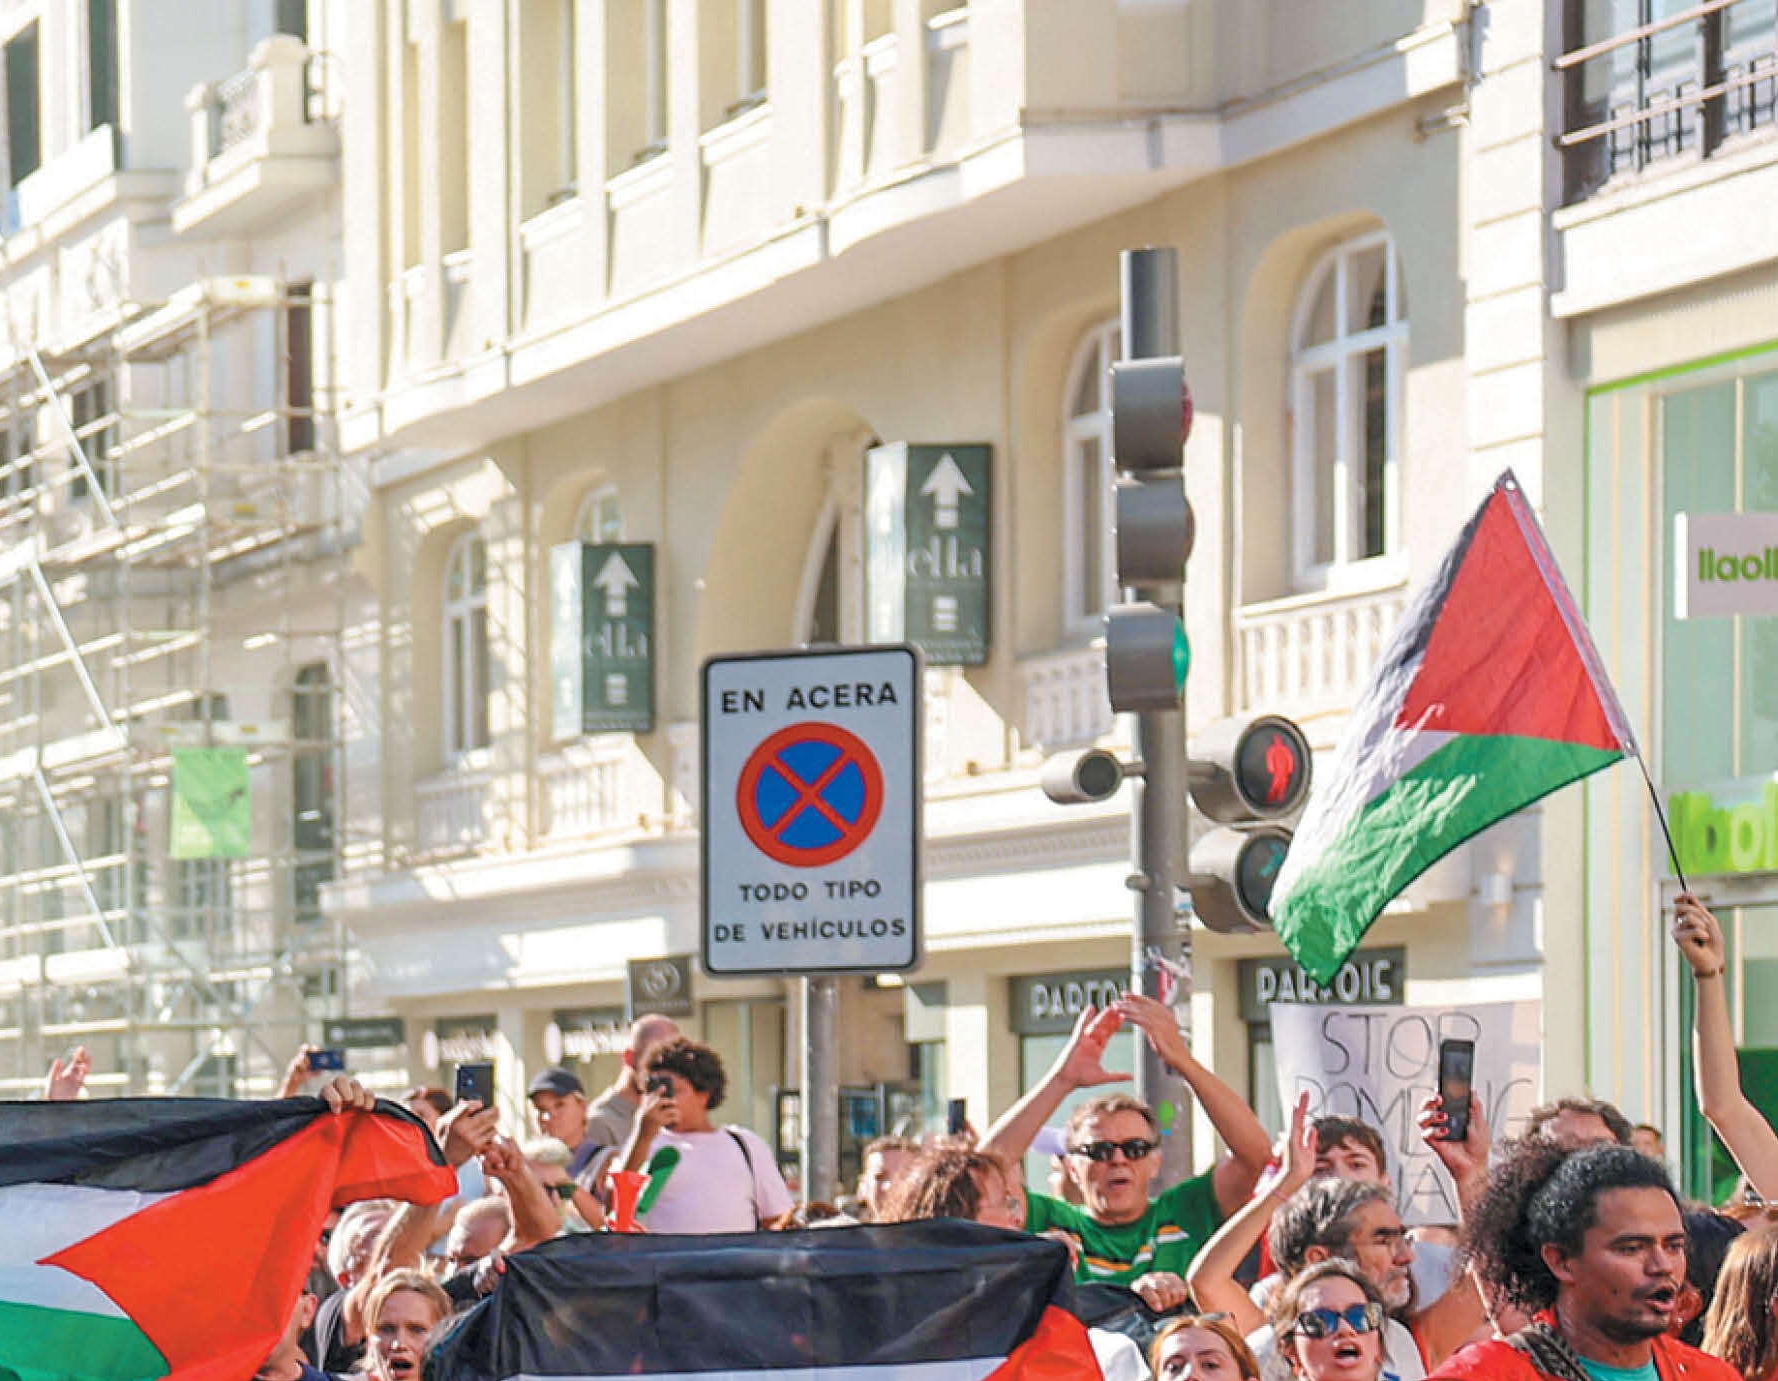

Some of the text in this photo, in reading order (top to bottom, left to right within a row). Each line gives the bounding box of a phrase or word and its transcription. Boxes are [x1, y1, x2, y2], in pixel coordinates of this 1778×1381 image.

[721, 681, 899, 713] EN ACERA
[739, 879, 882, 902] TODO TIPO
[714, 916, 907, 943] DE VEHÍCULOS
[1255, 960, 1392, 1004] PAROIS
